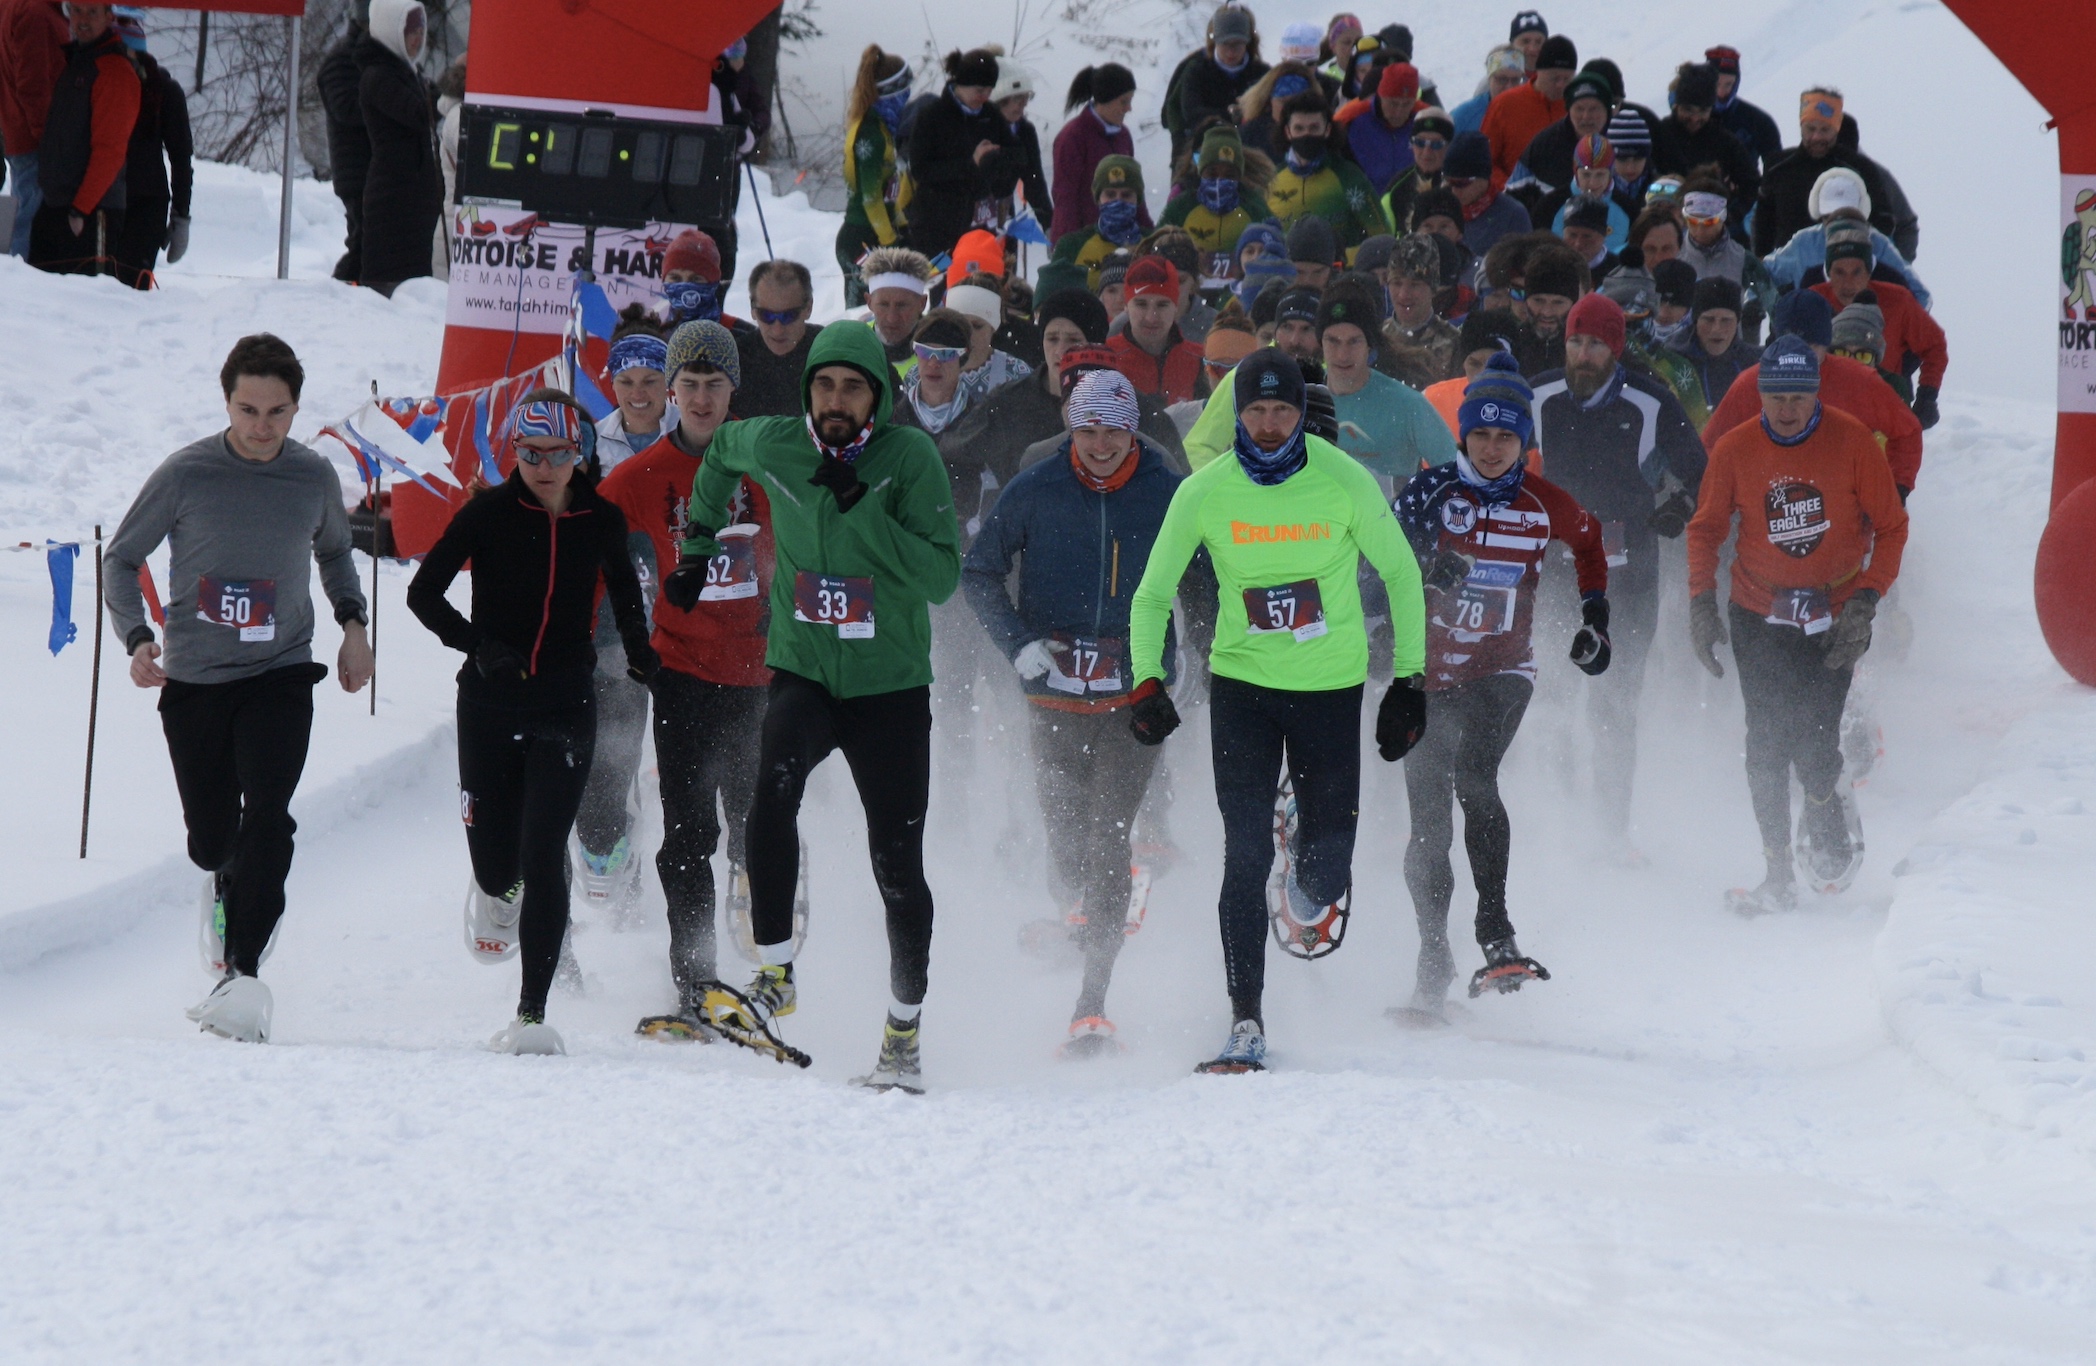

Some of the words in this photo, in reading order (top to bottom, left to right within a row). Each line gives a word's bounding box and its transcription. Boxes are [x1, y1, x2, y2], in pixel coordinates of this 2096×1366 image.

[453, 237, 557, 271] ORTOISE
[603, 247, 664, 278] HAR
[1213, 259, 1230, 277] 27
[465, 296, 569, 315] www.tandhtim
[1782, 497, 1822, 518] THREE
[1769, 513, 1808, 533] EAGLE
[1467, 565, 1517, 585] unReg
[221, 594, 251, 624] 50
[818, 590, 848, 620] 33
[1266, 597, 1296, 628] 57
[1455, 599, 1484, 628] 78
[1790, 597, 1811, 622] 14
[1072, 648, 1099, 677] 17
